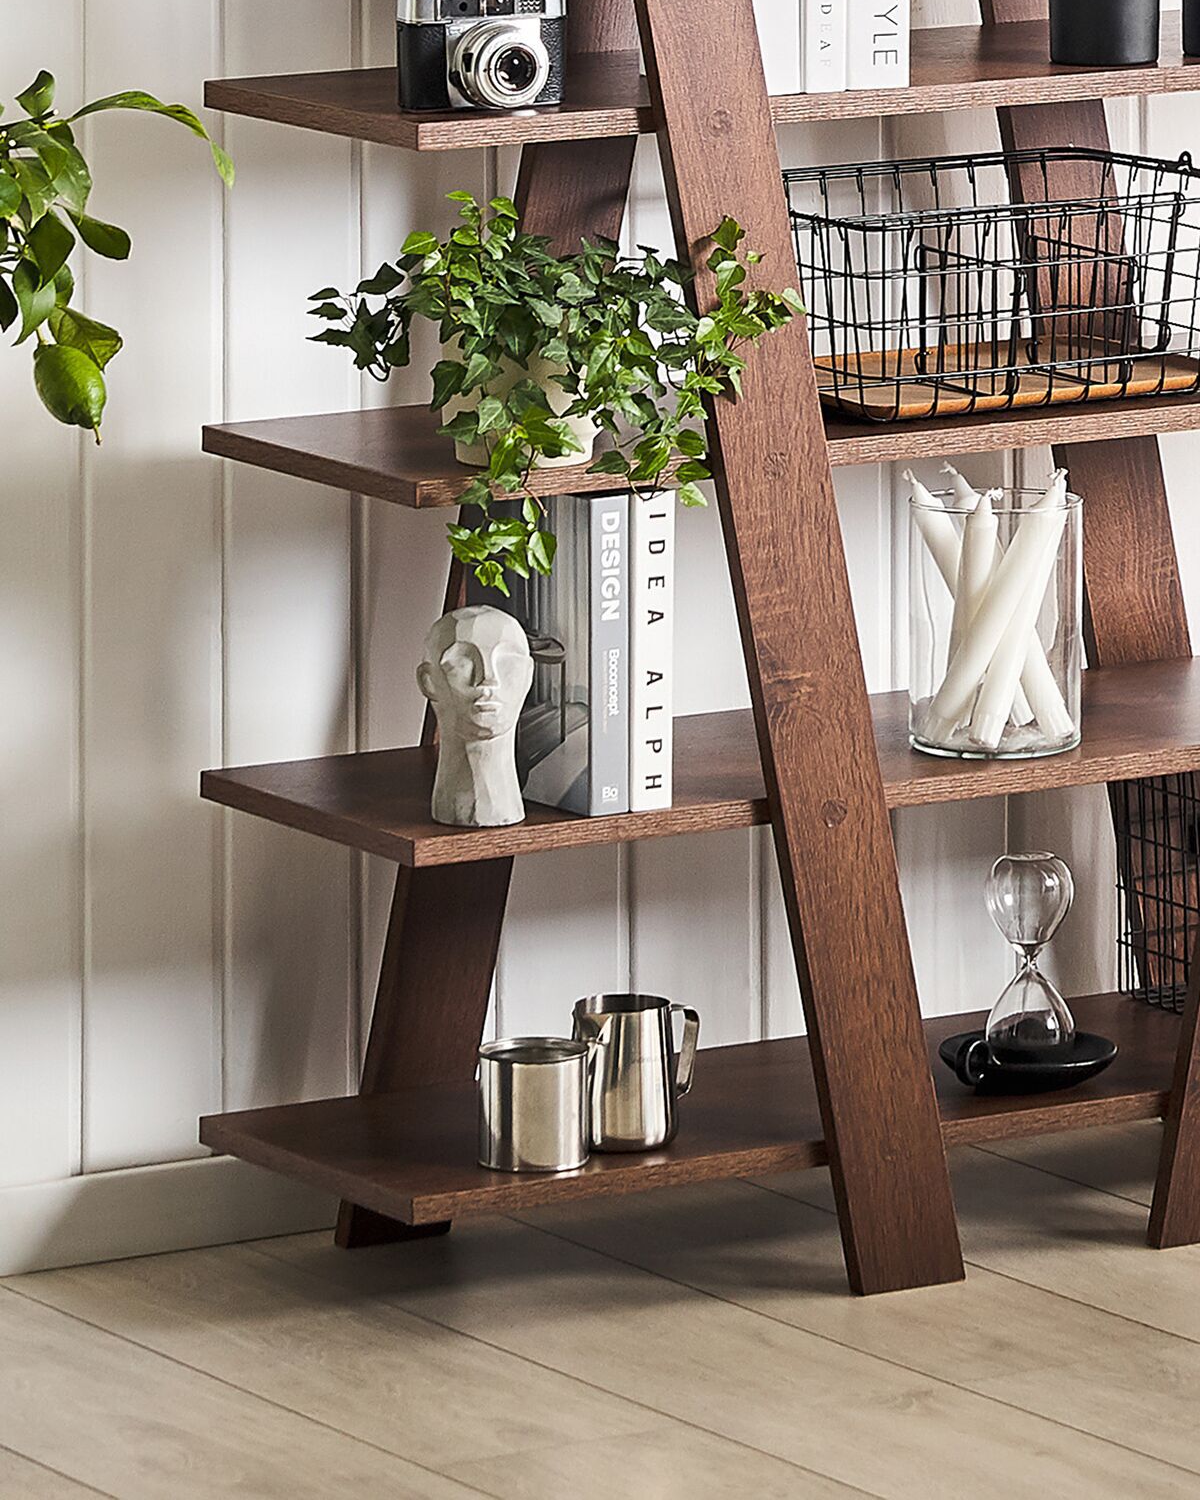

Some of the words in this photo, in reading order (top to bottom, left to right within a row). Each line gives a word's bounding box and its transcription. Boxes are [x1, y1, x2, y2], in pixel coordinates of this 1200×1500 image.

[601, 510, 621, 622] DESIGN
[648, 513, 666, 625] IDEA
[607, 648, 620, 716] Boconcept
[645, 669, 664, 790] ALPH
